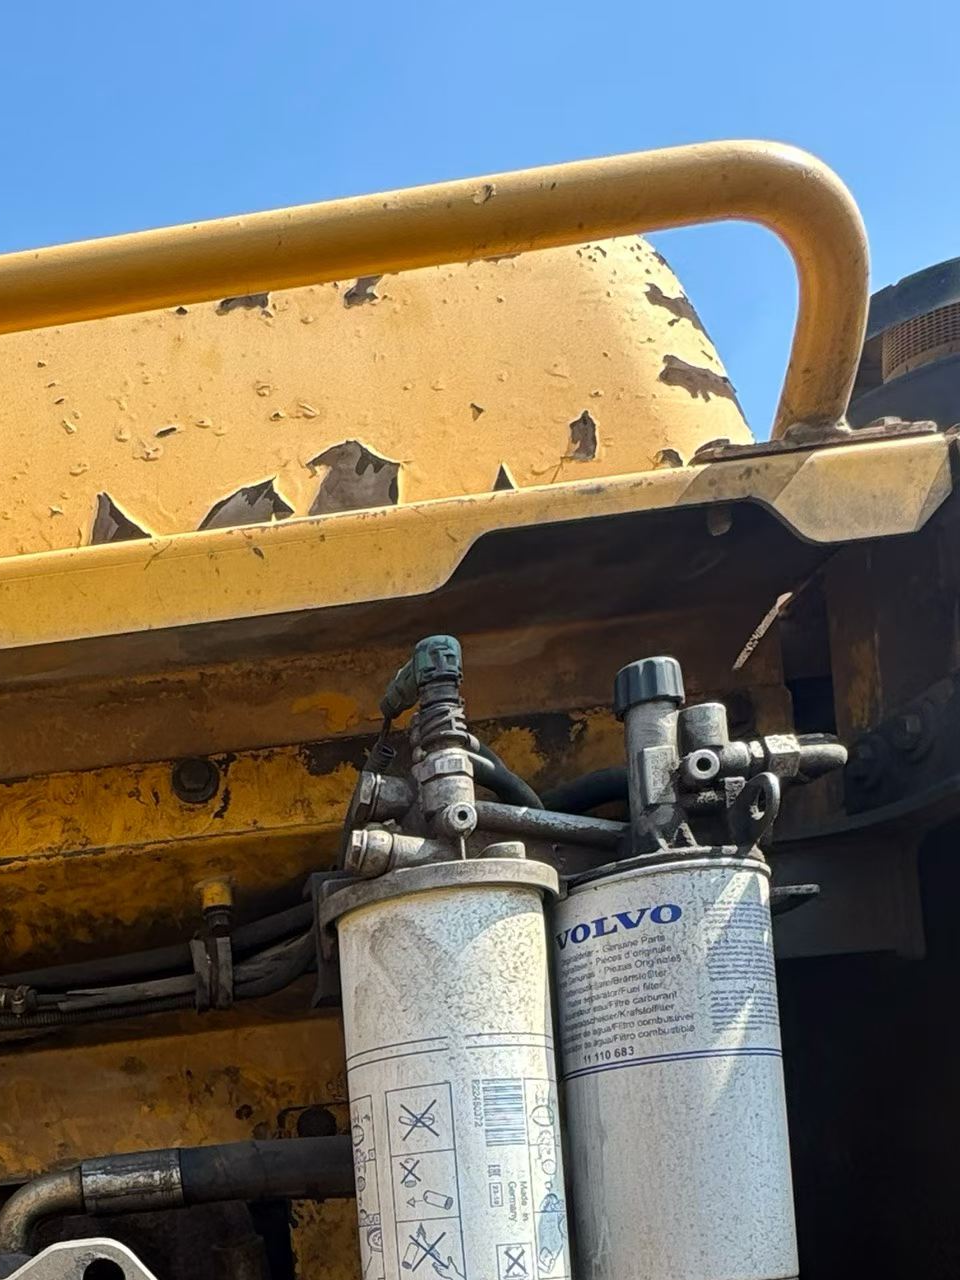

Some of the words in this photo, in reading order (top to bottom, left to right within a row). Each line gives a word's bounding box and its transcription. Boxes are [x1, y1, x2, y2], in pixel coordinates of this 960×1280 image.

[556, 903, 682, 950] VOLVO
[595, 1050, 611, 1061] 110
[614, 1045, 635, 1058] 683
[507, 1180, 517, 1223] Germany
